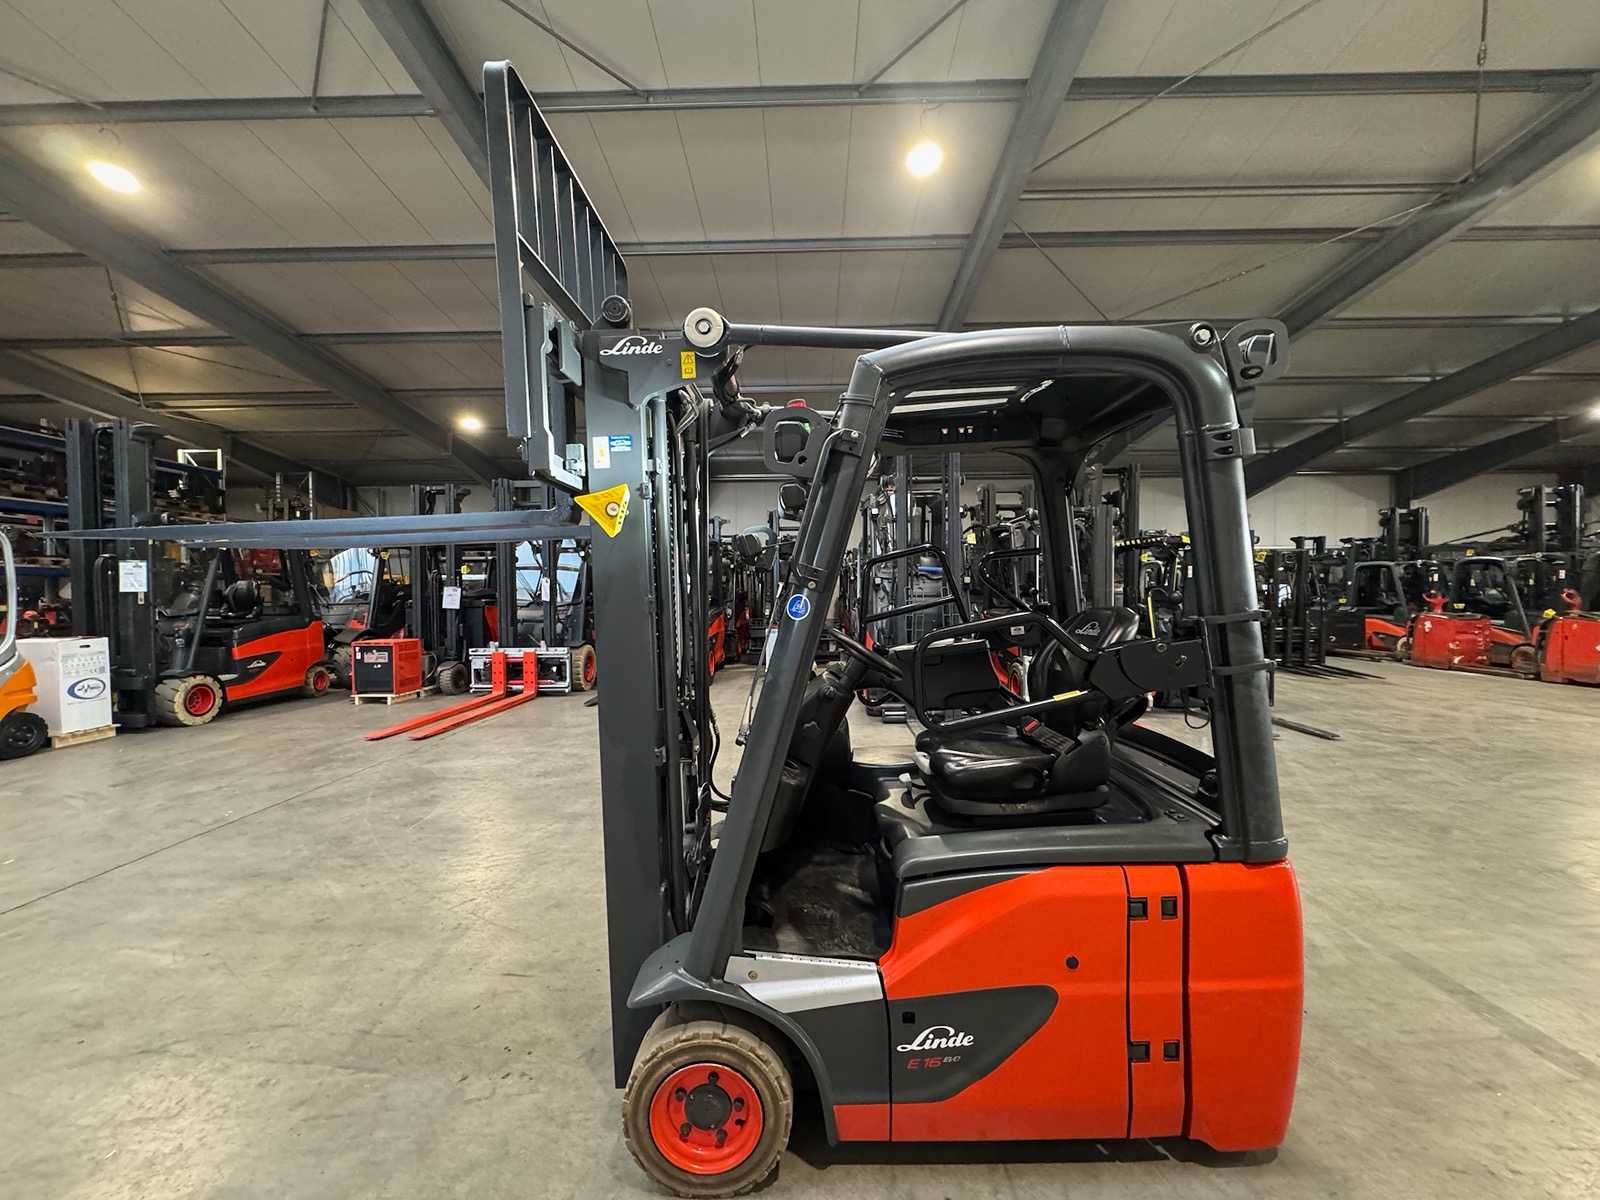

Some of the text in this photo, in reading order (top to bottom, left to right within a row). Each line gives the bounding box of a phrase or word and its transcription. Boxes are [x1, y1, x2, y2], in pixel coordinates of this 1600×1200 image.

[600, 335, 664, 356] Linde
[896, 1025, 975, 1052] Linde
[906, 1056, 921, 1069] E
